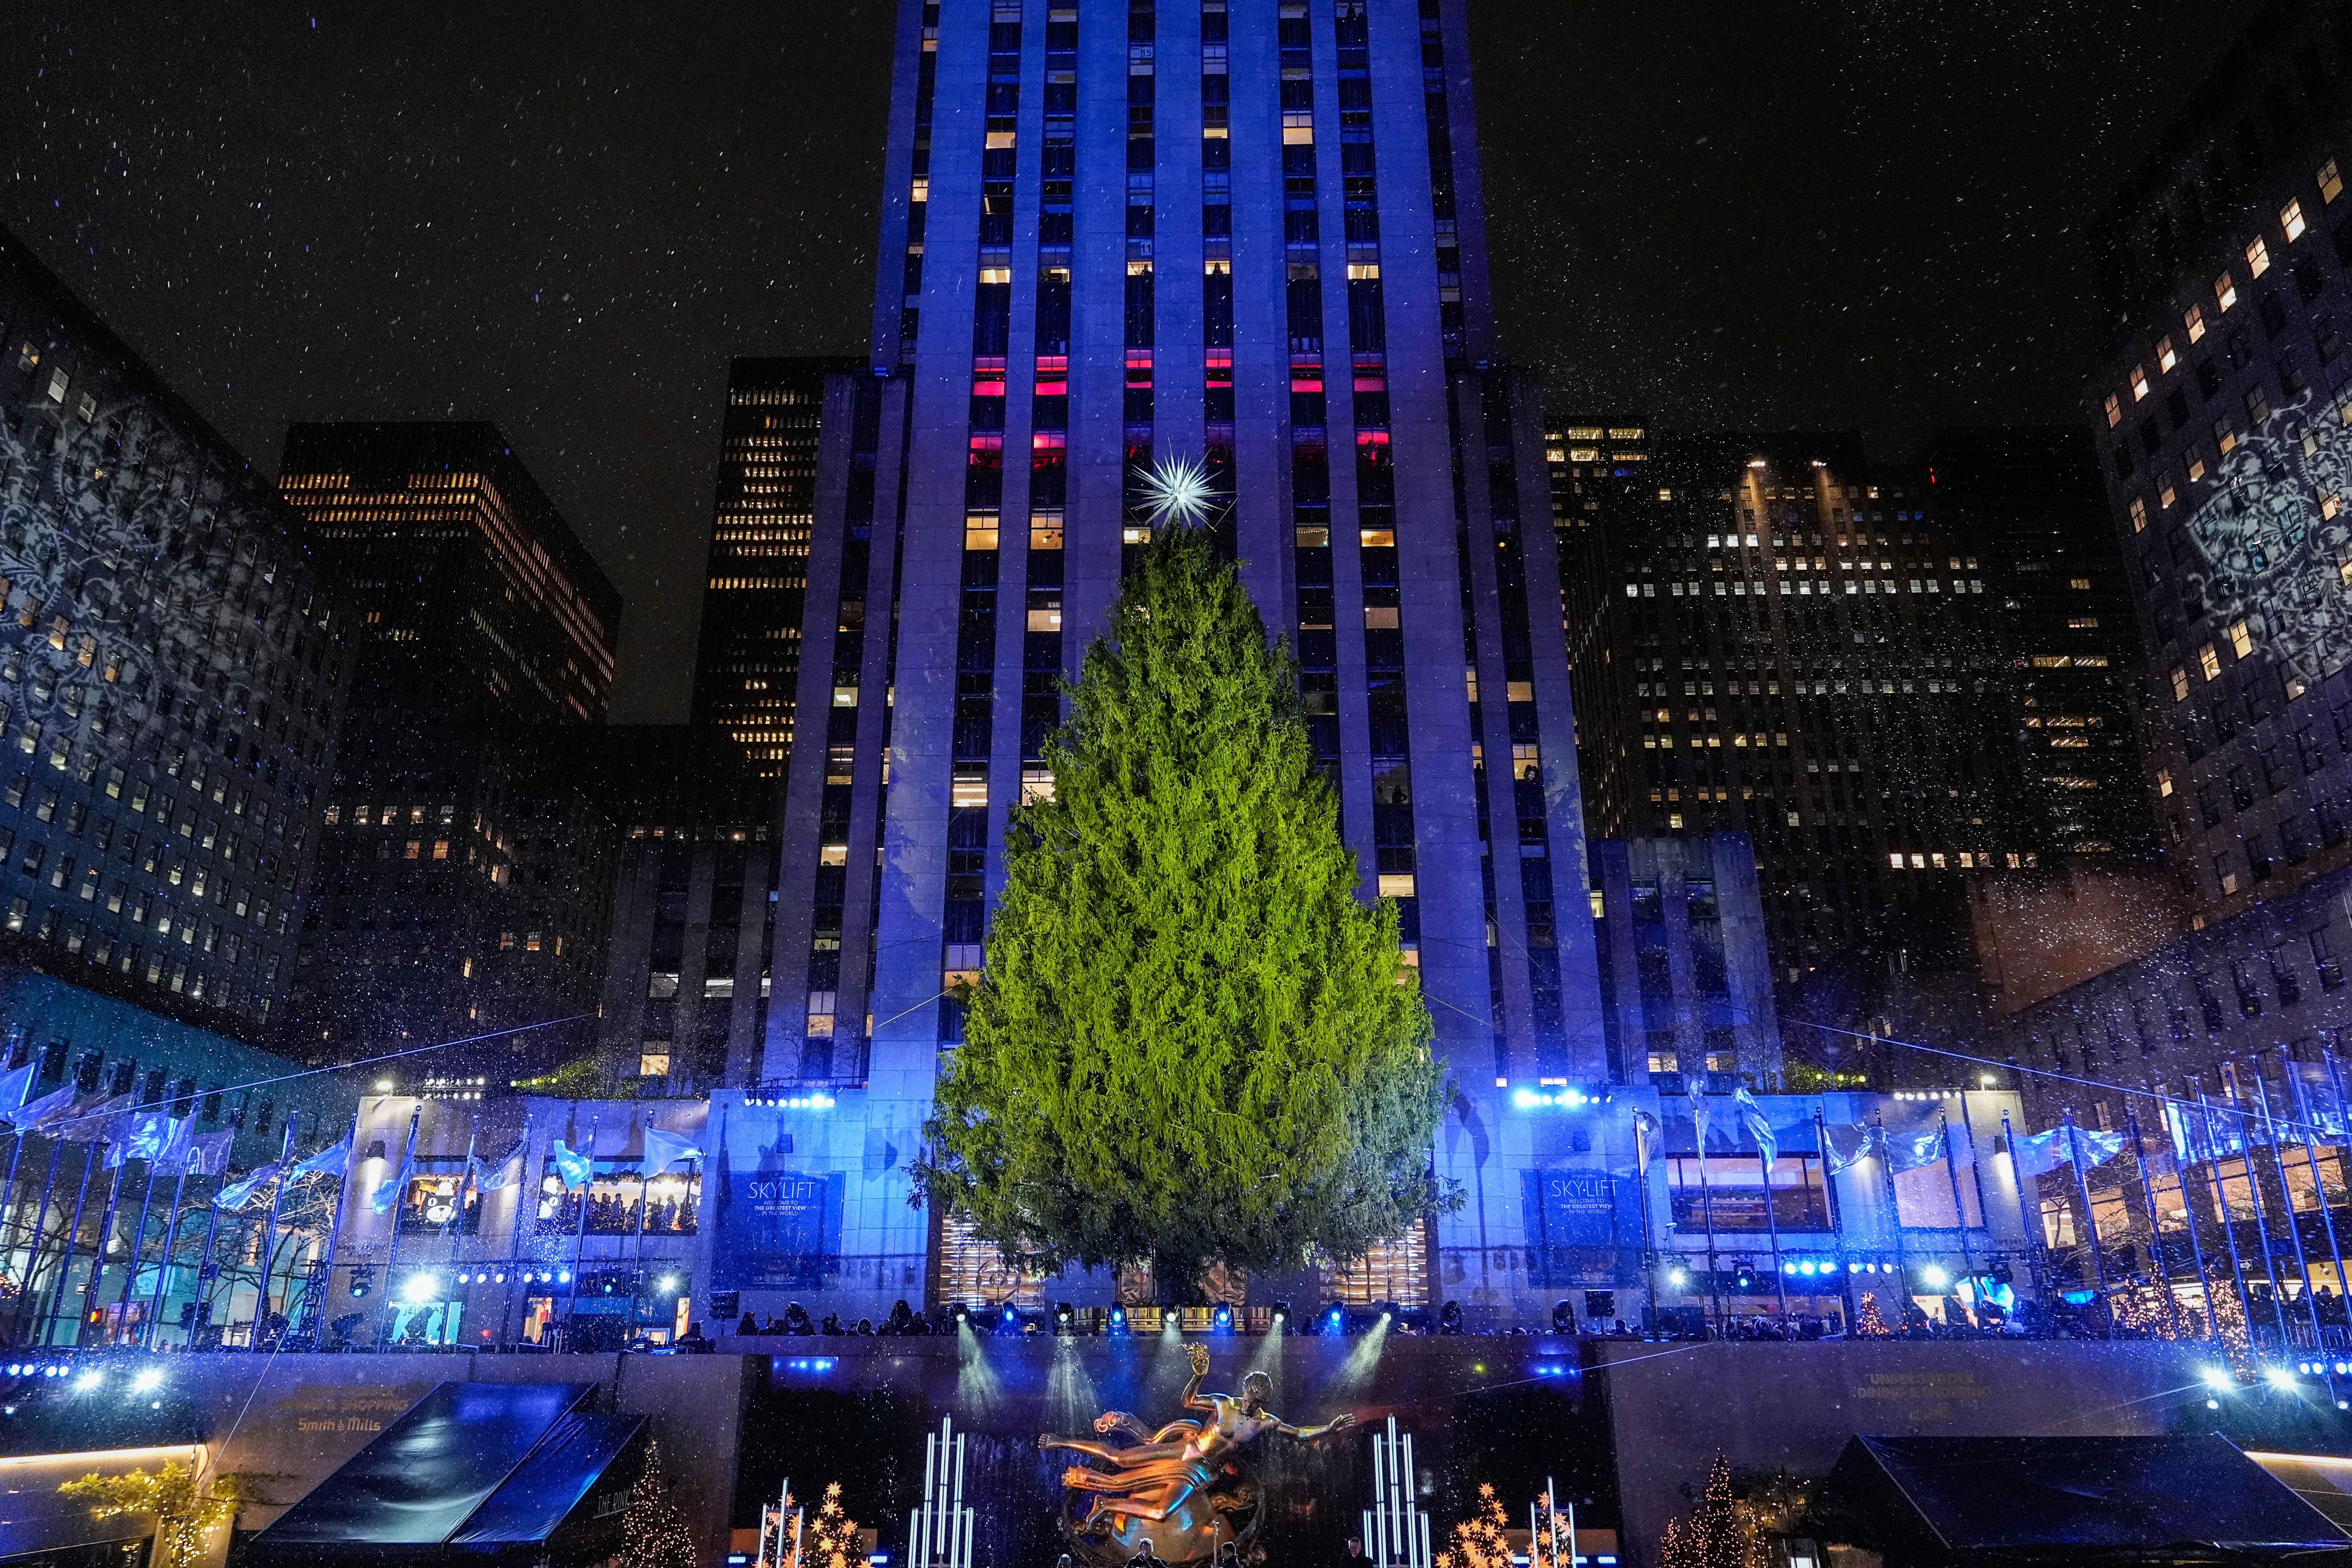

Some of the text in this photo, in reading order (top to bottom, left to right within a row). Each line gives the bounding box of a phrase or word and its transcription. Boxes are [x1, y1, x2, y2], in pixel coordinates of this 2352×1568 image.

[1141, 244, 1151, 253] 11
[748, 1182, 816, 1199] SKYLIFT
[1552, 1180, 1619, 1197] SKYLIFT
[298, 1418, 335, 1432] Smith
[347, 1417, 381, 1431] Mills
[612, 1488, 632, 1511] RINK
